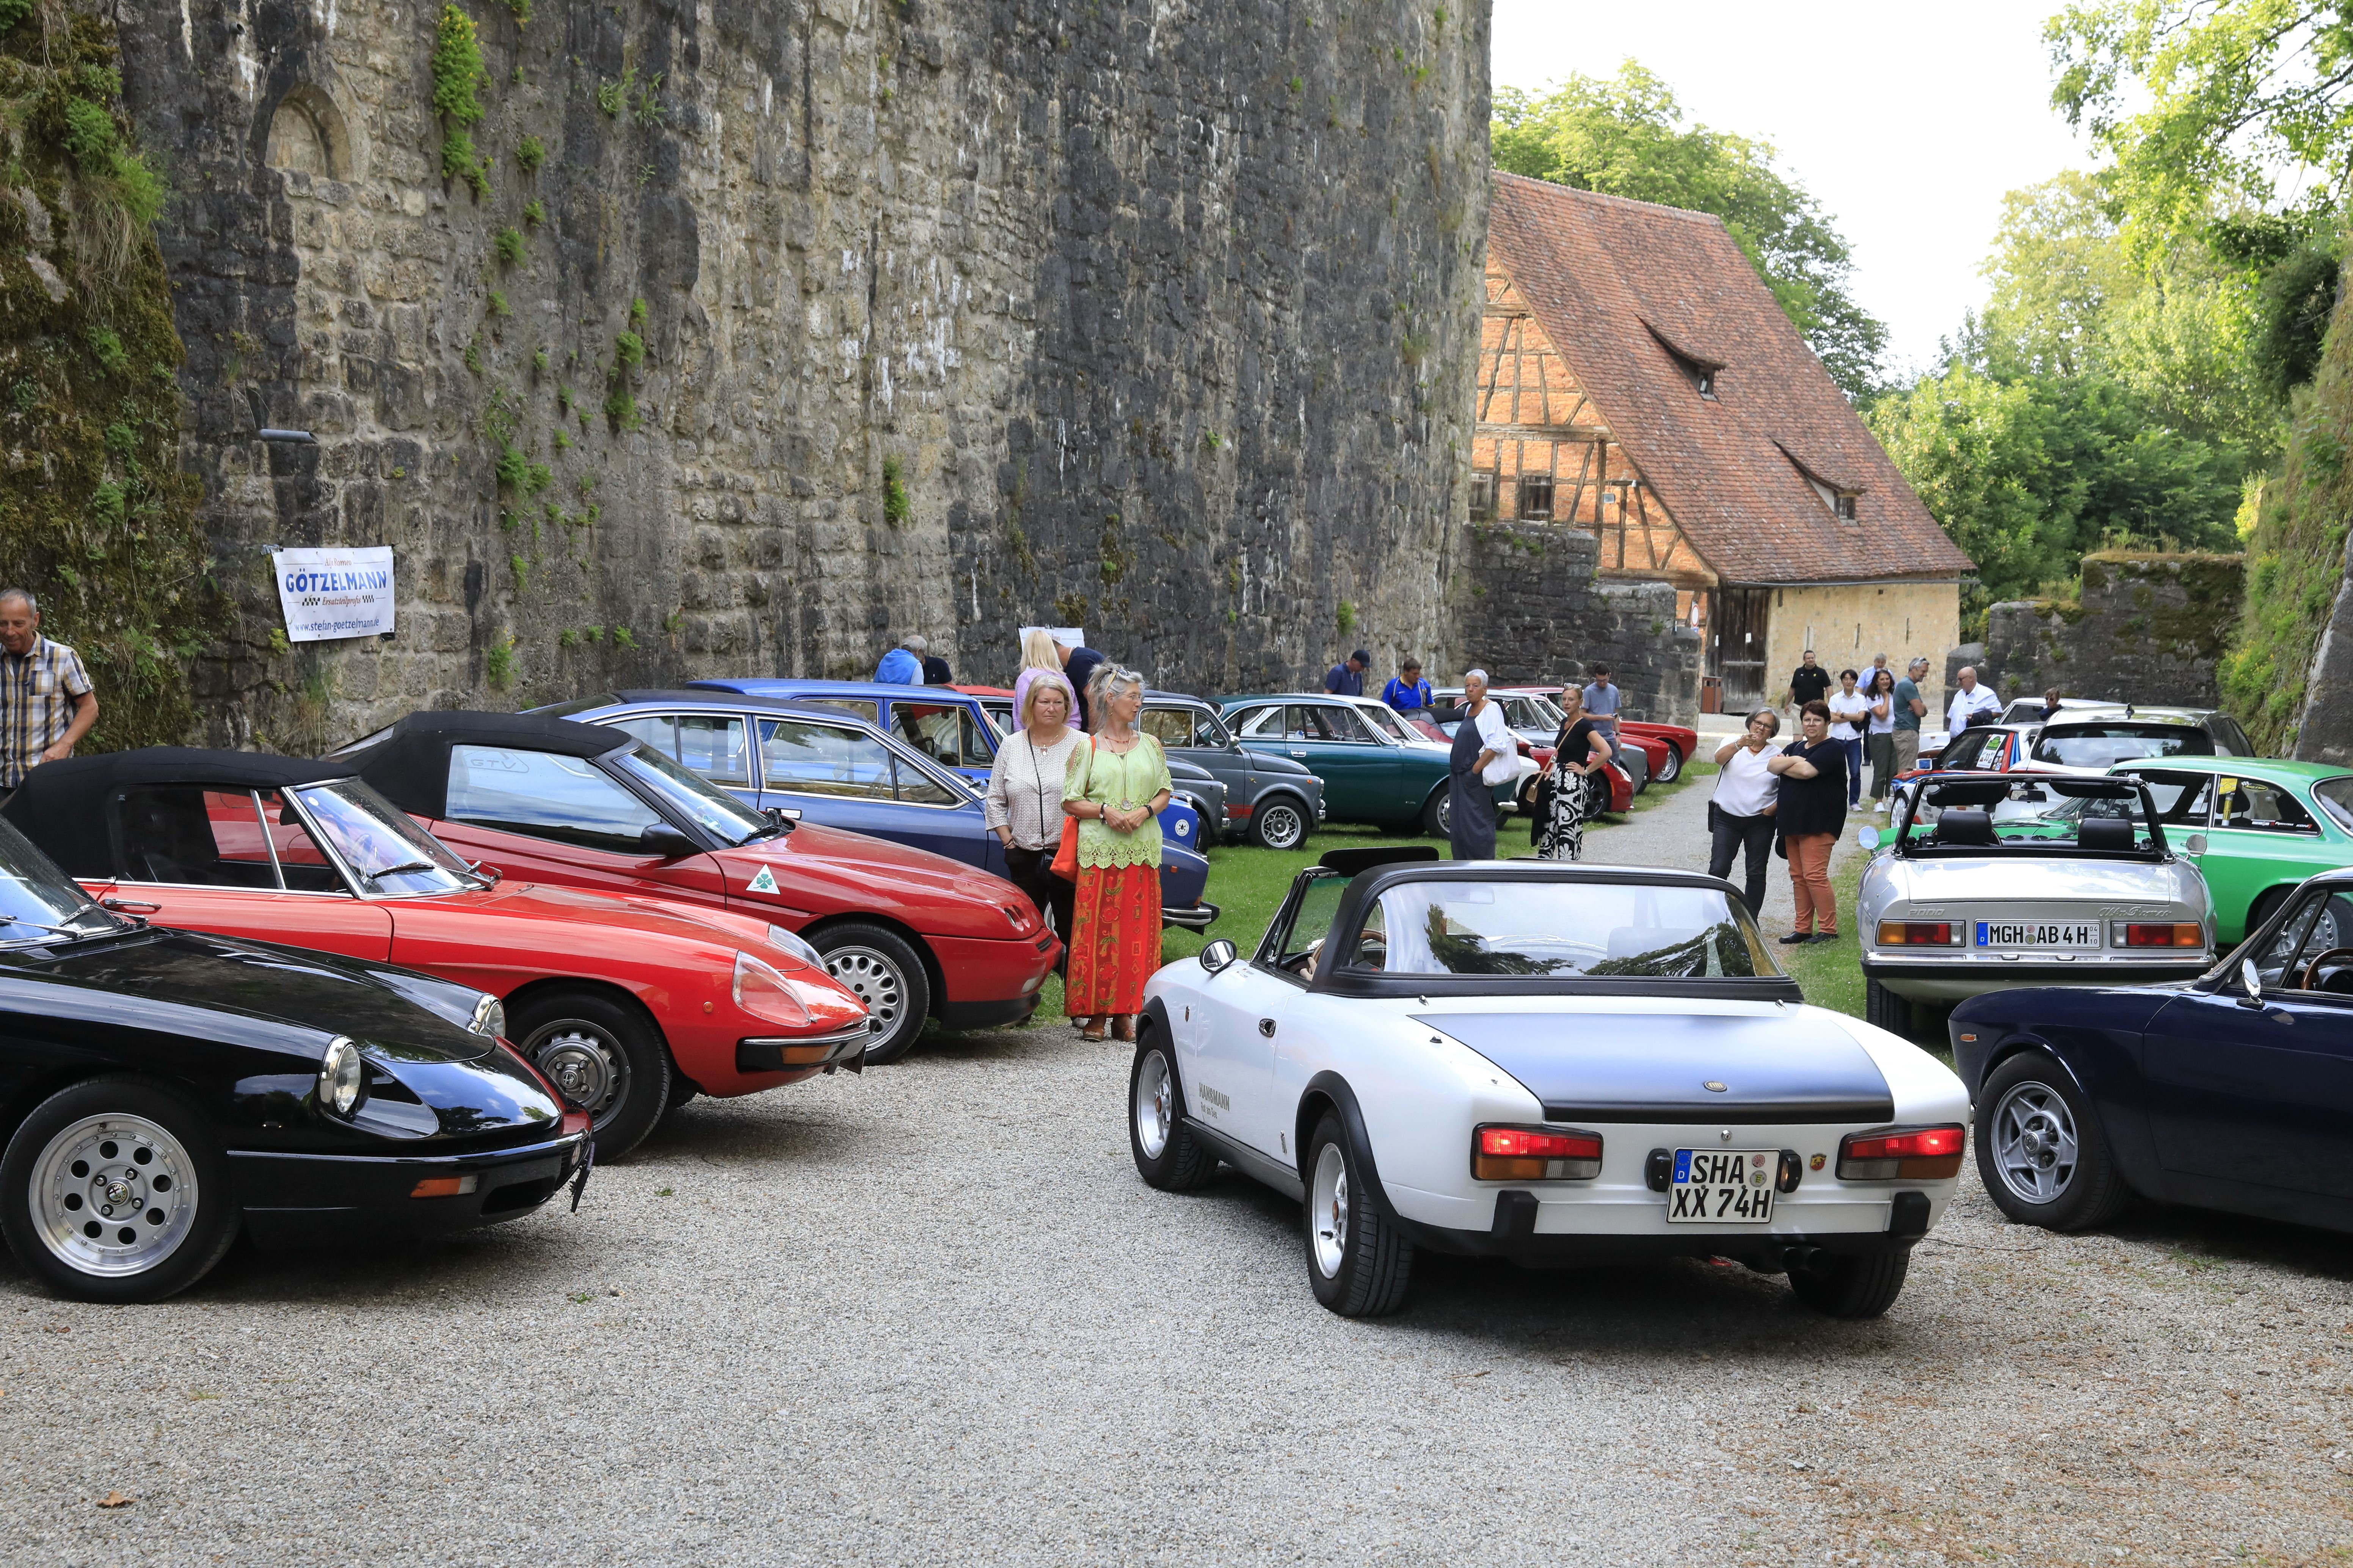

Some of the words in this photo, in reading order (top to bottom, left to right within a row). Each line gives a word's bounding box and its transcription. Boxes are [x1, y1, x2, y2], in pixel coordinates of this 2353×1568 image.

[325, 558, 334, 569] Alfa
[334, 558, 352, 566] Romeo
[285, 568, 387, 593] GÖTZELMANN
[322, 596, 361, 607] Ersatzteilprofis
[294, 618, 380, 633] www.stefan-goetzelmann.de
[470, 759, 516, 769] GTV
[1989, 926, 2024, 943] MGH
[1199, 1082, 1230, 1112] HANSMANN
[1678, 1170, 1685, 1179] D
[1691, 1155, 1744, 1184] SHA
[1672, 1188, 1709, 1217] XX
[1717, 1189, 1771, 1218] 74H
